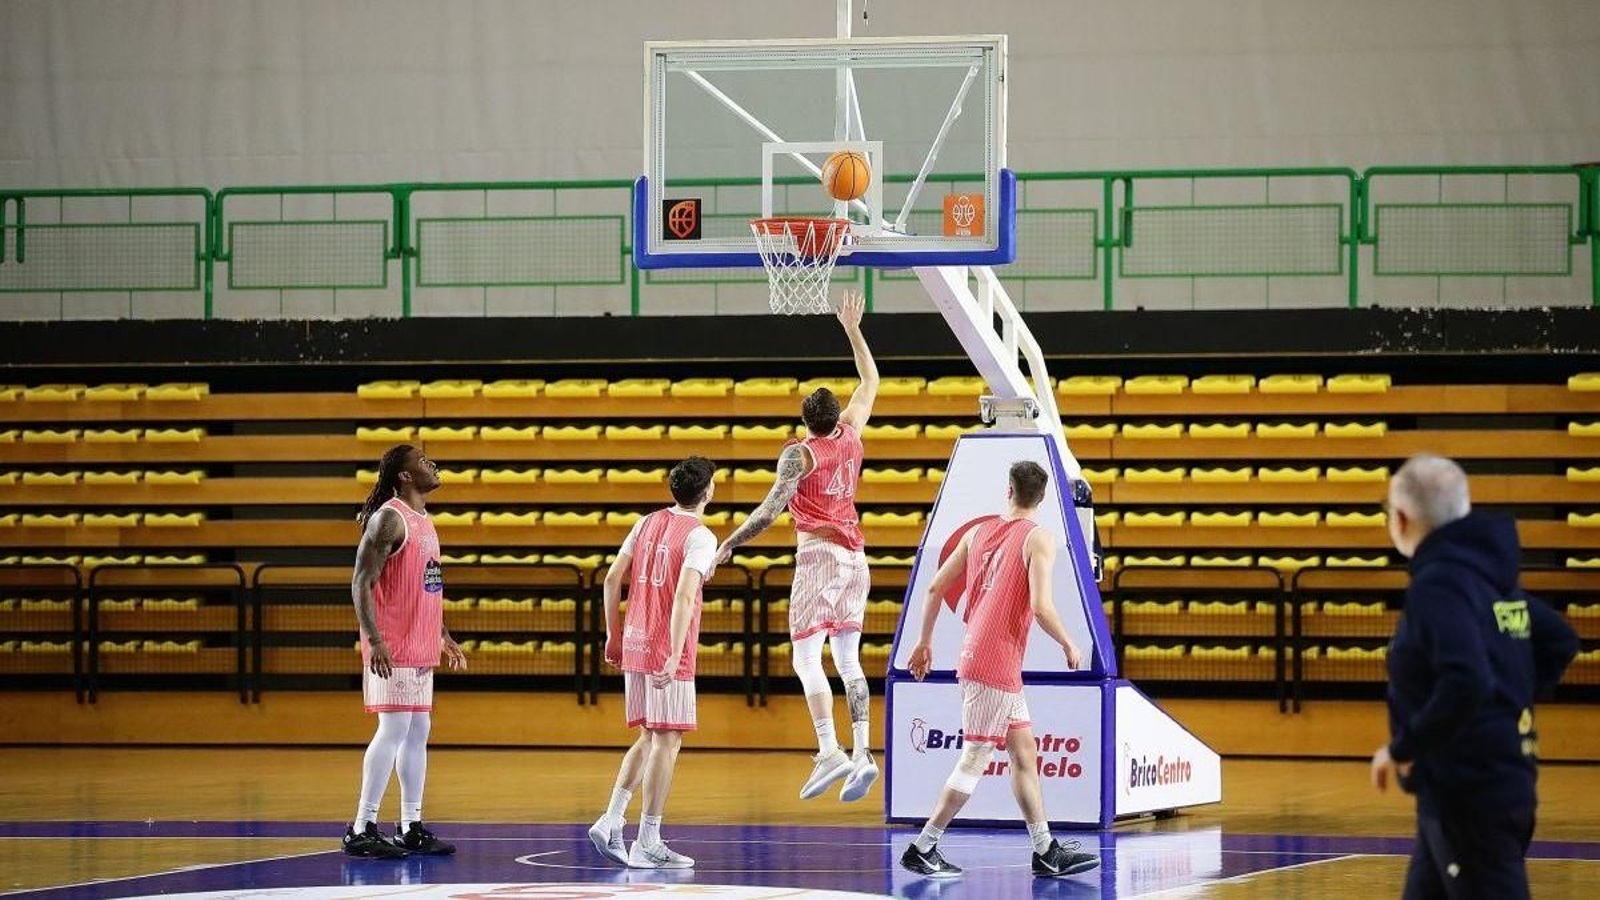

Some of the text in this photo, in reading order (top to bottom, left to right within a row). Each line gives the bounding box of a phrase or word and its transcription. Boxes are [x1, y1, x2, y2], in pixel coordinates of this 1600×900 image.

[827, 459, 854, 500] 41
[638, 541, 669, 587] 10
[1130, 754, 1192, 789] BricoCentro
